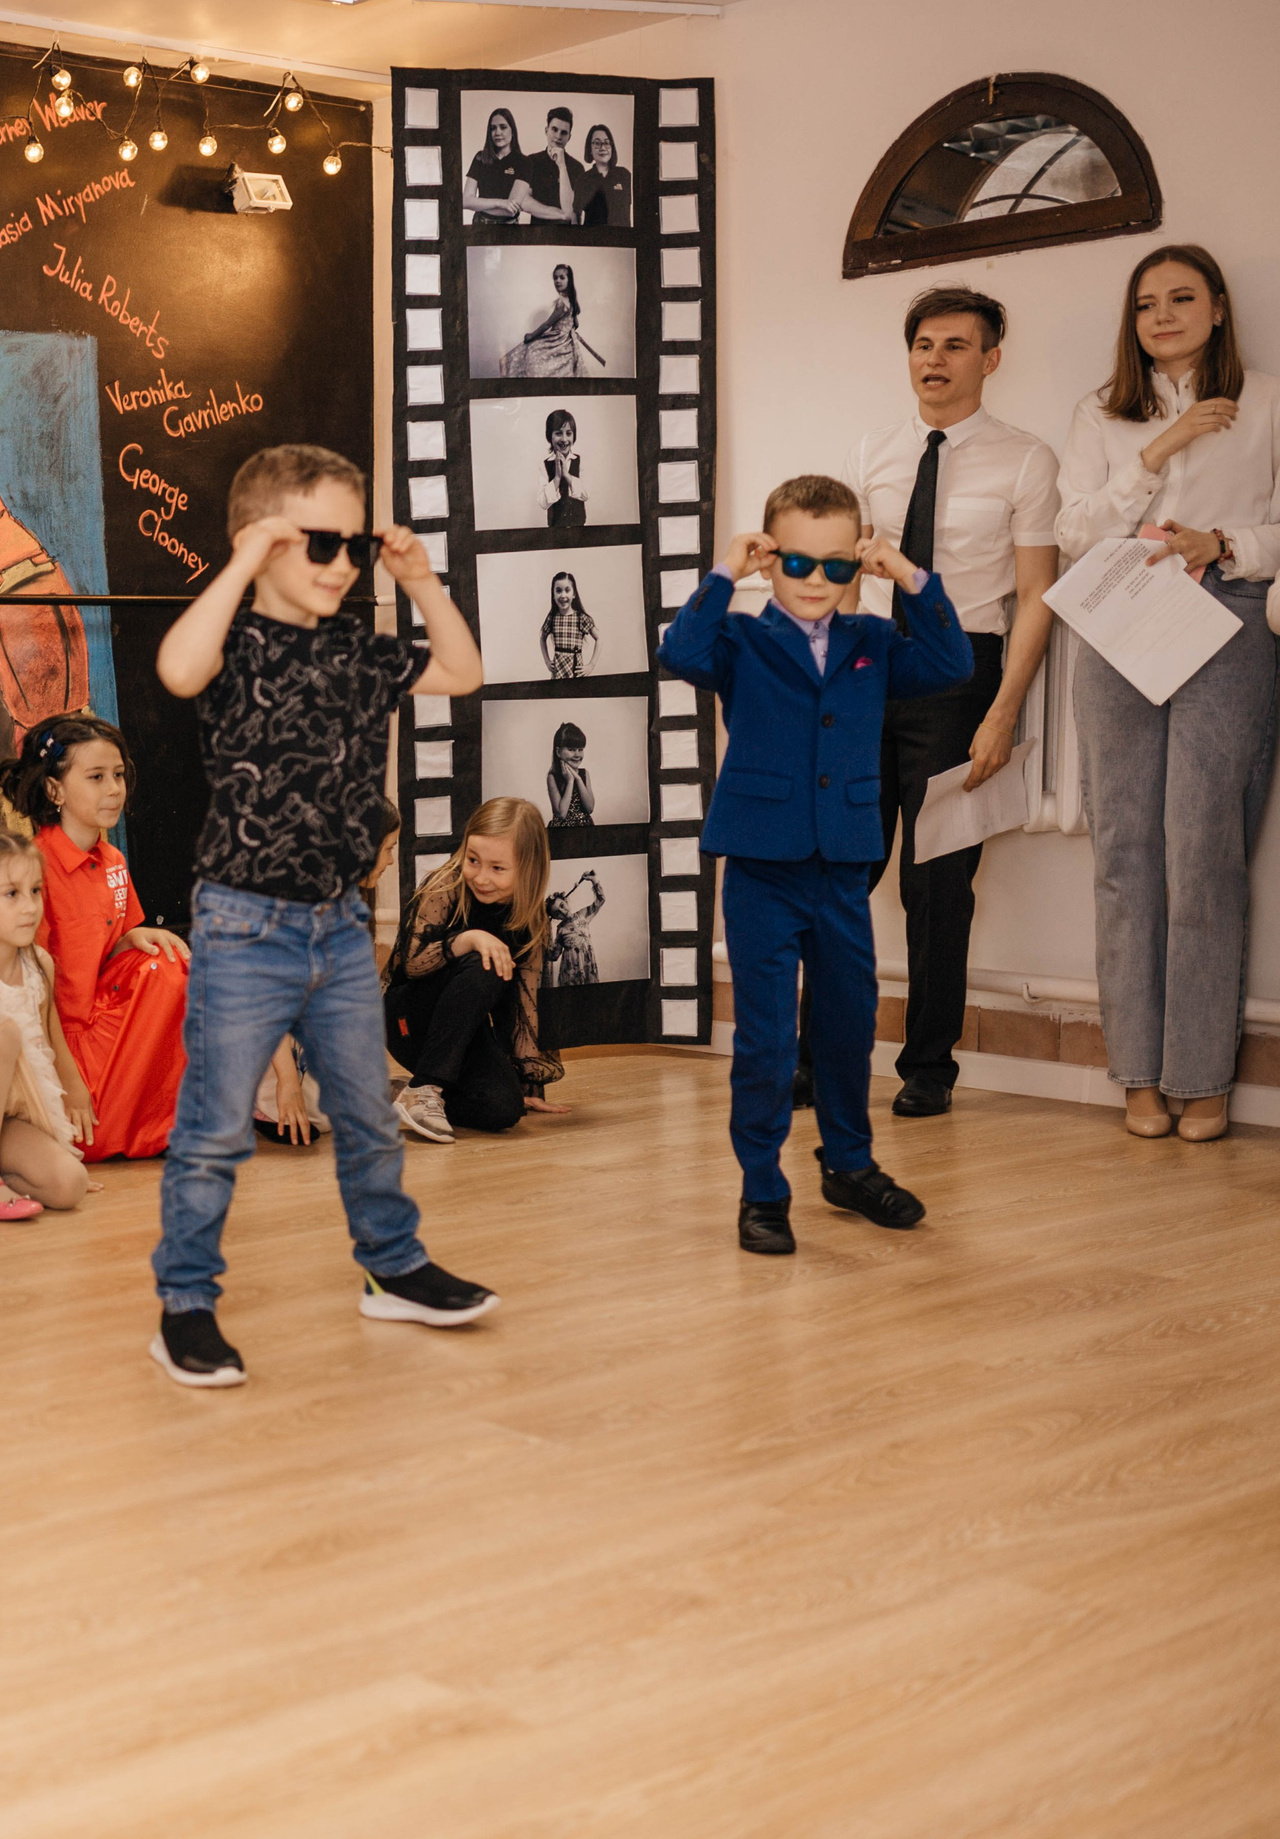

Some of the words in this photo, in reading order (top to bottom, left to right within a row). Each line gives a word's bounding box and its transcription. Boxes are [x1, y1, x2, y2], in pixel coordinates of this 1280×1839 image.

[35, 168, 135, 224] Miryanova
[42, 243, 94, 302] Julia
[98, 274, 170, 360] Roberts
[104, 368, 193, 415] Veronika
[162, 380, 264, 439] Gavrilenko
[119, 443, 190, 521] George
[138, 508, 210, 584] Clooney
